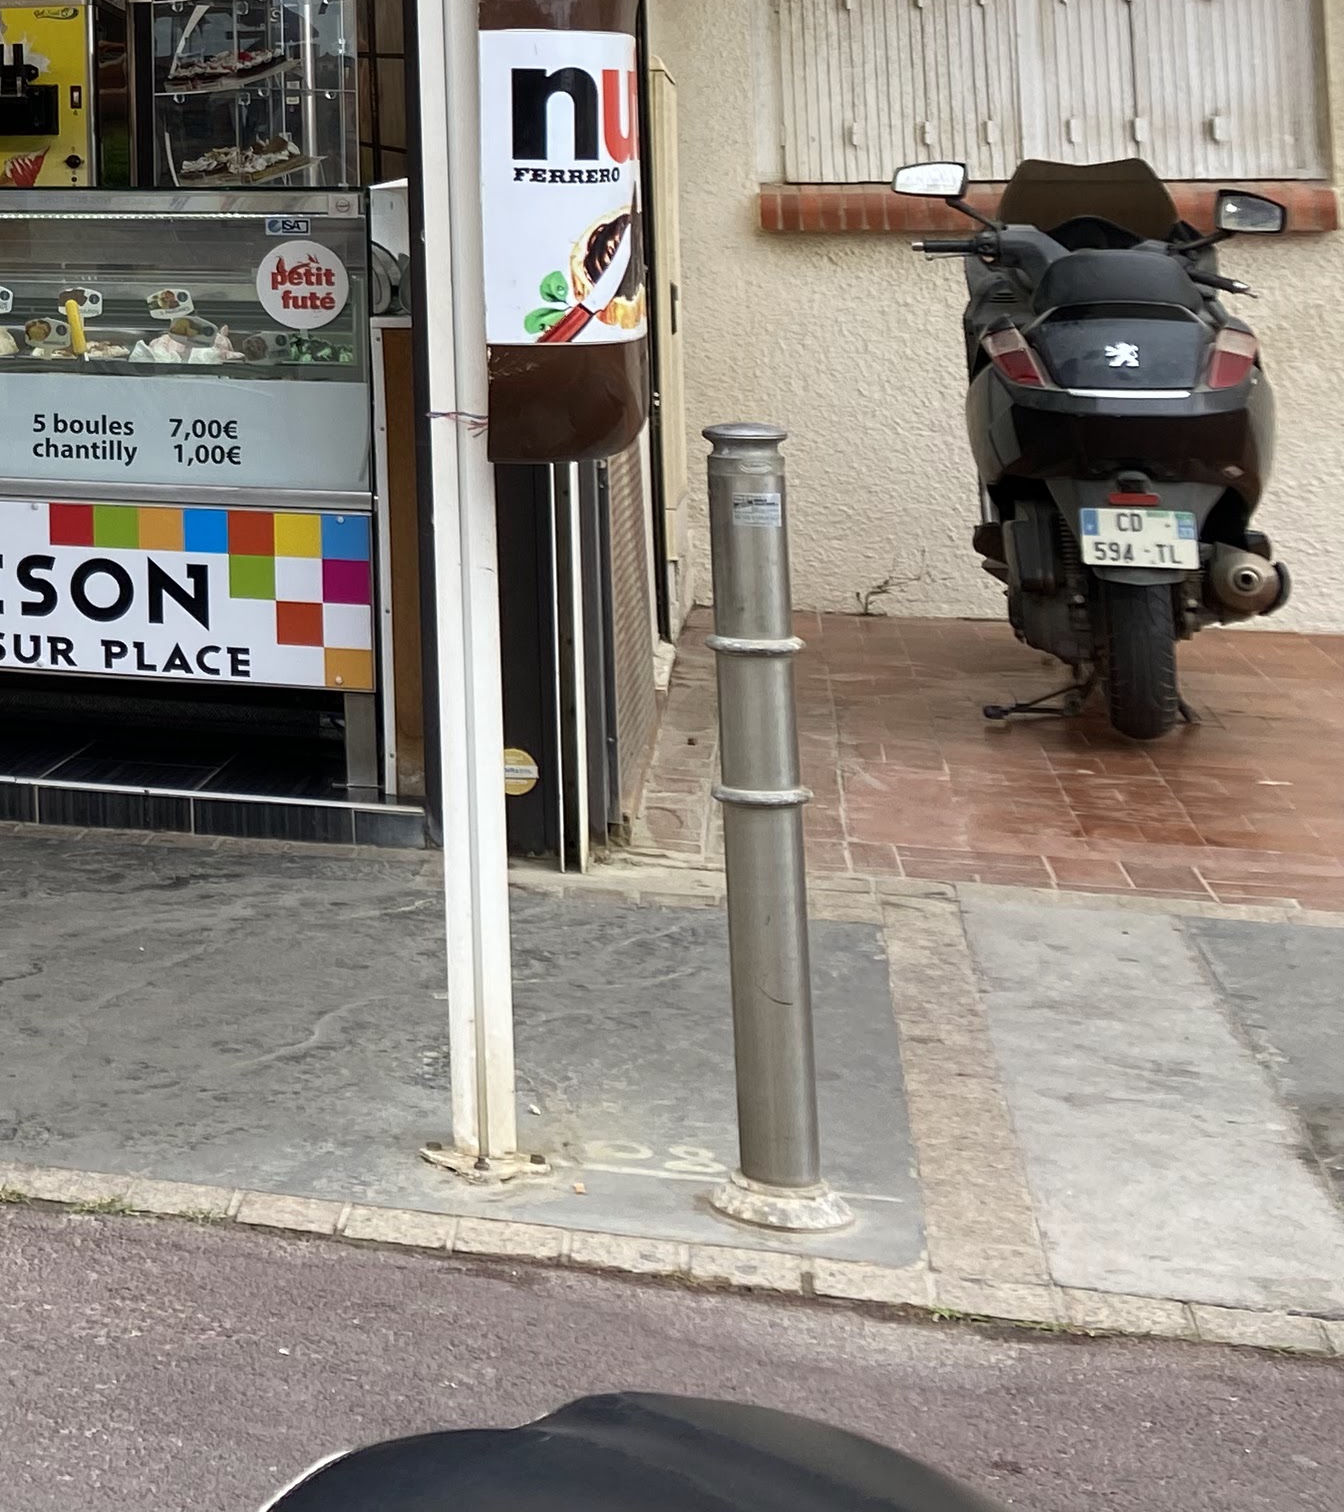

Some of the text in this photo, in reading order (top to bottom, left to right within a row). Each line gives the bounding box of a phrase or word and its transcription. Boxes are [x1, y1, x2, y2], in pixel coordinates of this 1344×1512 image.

[512, 67, 640, 162] nu
[514, 167, 621, 184] FERRERO
[271, 267, 335, 290] petit
[282, 290, 335, 310] futé
[33, 413, 239, 441] 5 boules 7,00€
[32, 438, 242, 466] chantilly 1,00€
[1117, 513, 1142, 532] CD
[104, 638, 252, 679] PLACE
